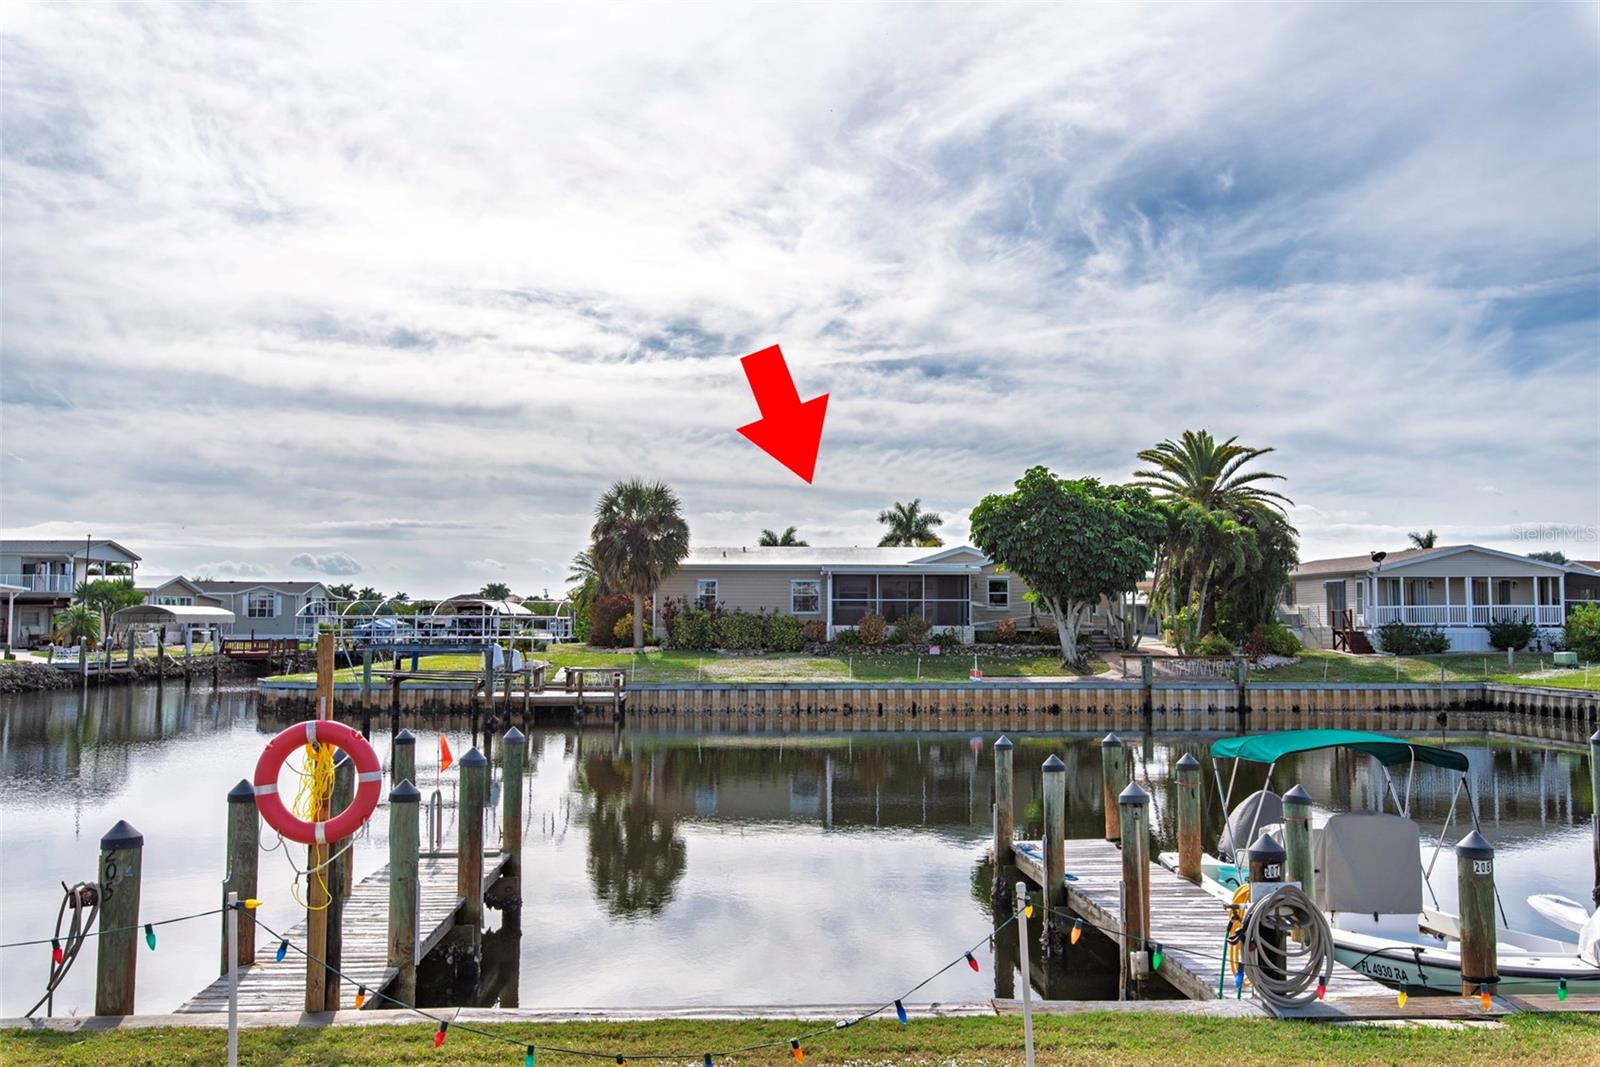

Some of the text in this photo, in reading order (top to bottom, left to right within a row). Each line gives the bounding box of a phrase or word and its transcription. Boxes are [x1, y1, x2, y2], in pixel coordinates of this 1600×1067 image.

[1361, 960, 1409, 981] FL 4930 RA
